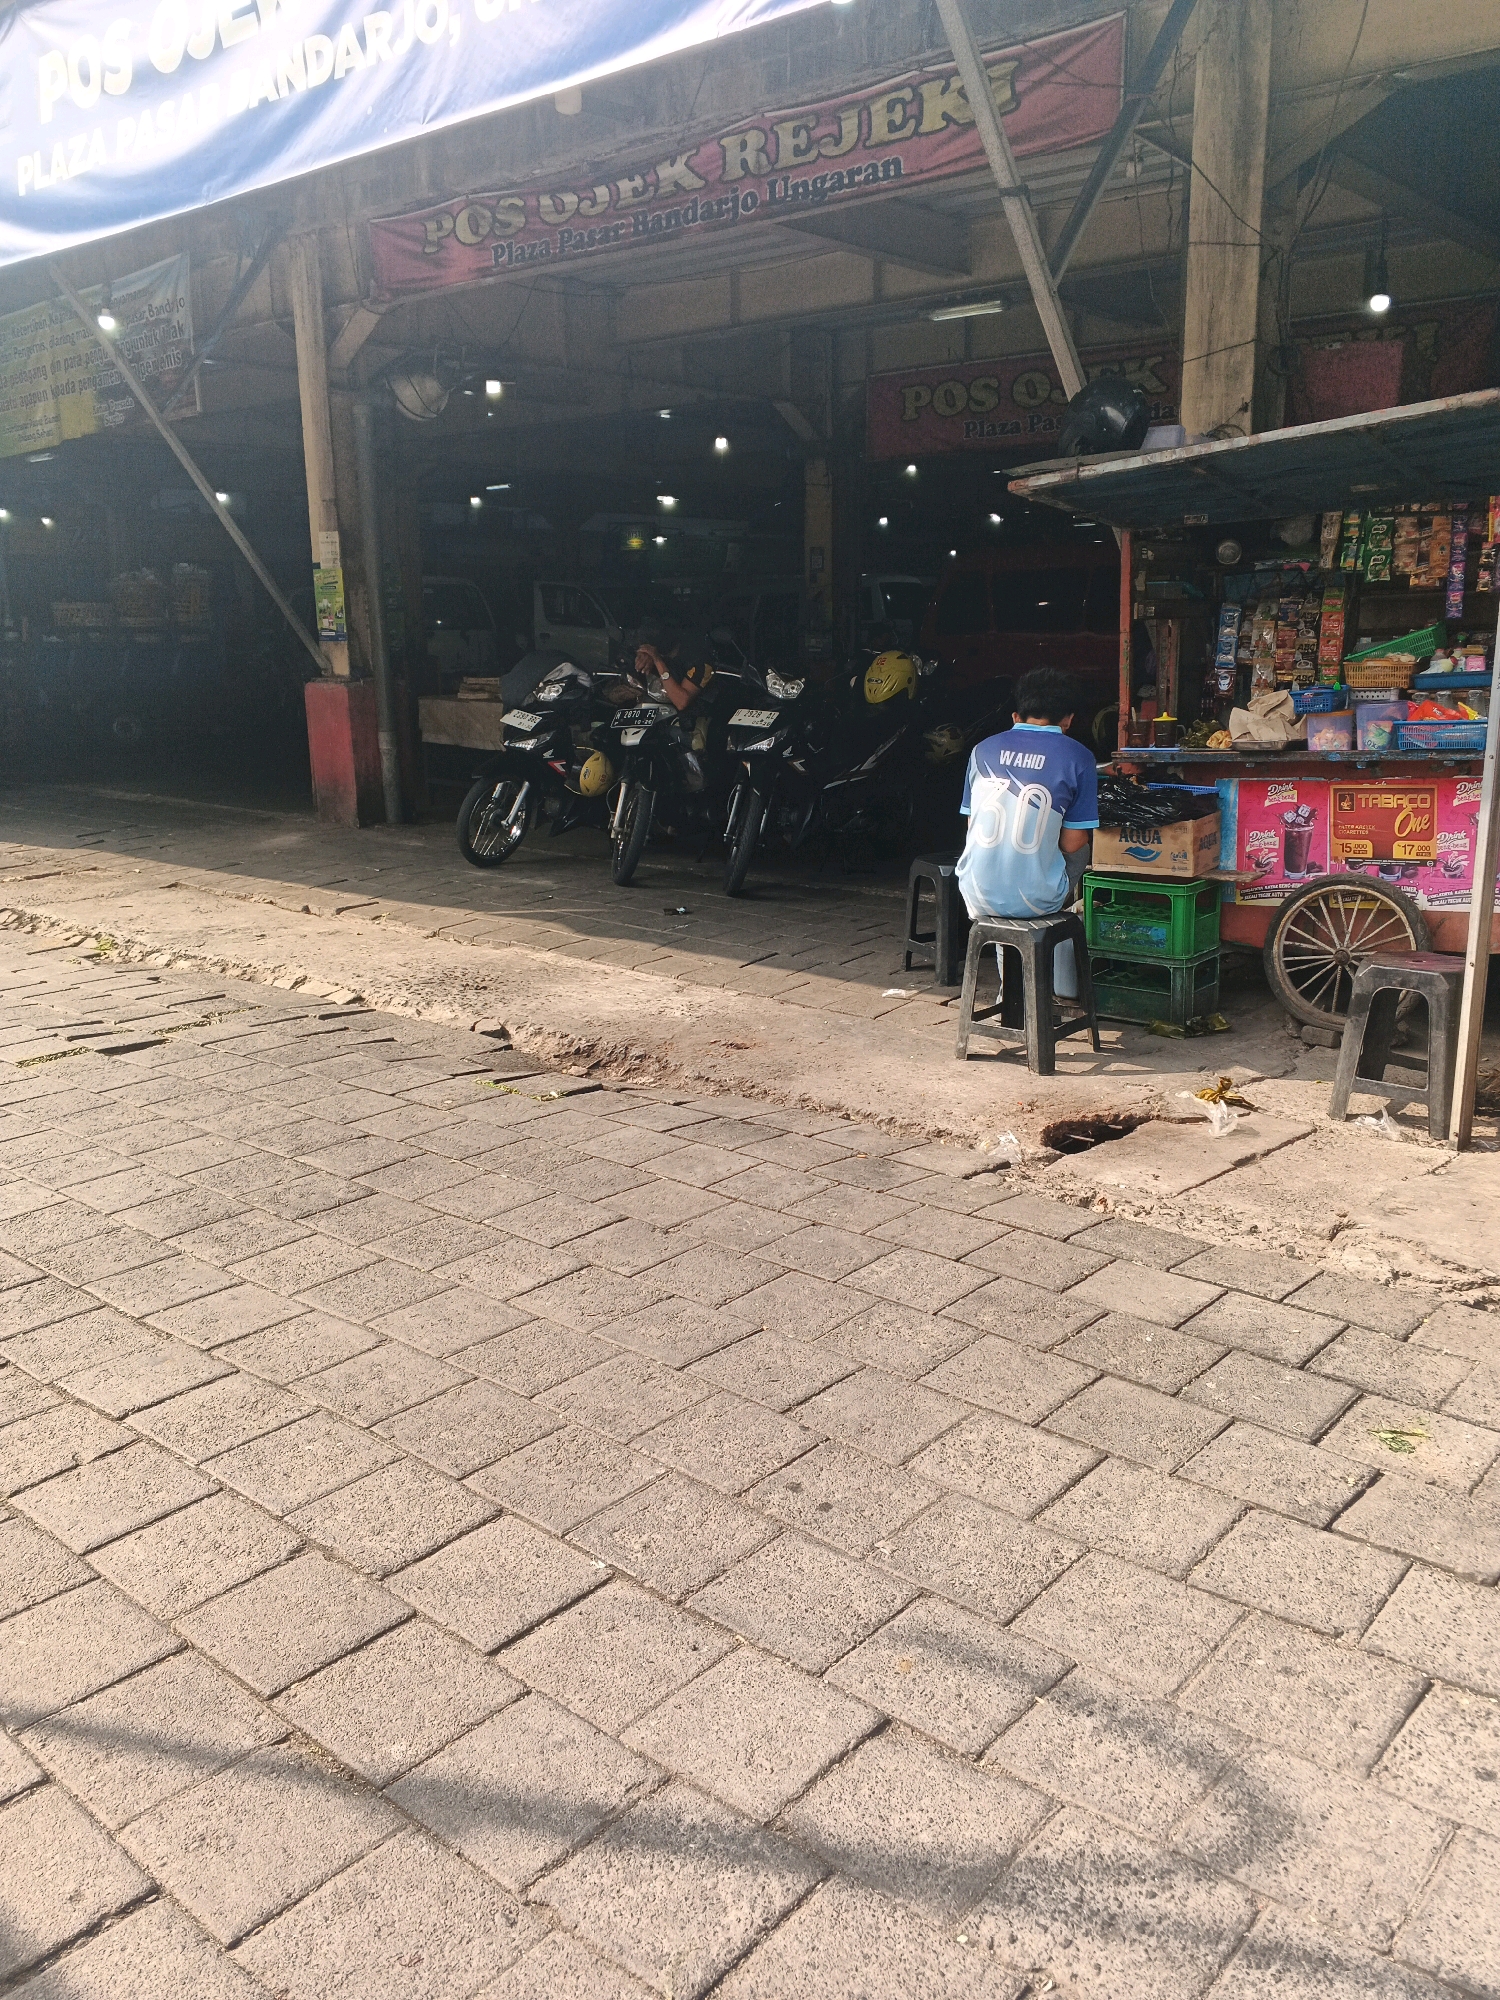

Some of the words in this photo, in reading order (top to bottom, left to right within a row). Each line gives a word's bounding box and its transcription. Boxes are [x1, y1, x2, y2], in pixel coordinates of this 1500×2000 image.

[38, 17, 134, 125] POS
[16, 128, 109, 197] PLAZA
[116, 80, 222, 159] PASAR
[424, 195, 527, 253] POS
[539, 149, 705, 224] OJEK
[491, 236, 551, 270] Plaza
[557, 219, 626, 254] Pasar
[632, 186, 761, 236] Bandarjo
[766, 156, 905, 207] Ungaran
[899, 377, 1000, 422] POS
[962, 417, 1022, 441] Plaza
[623, 710, 641, 719] 2870
[999, 749, 1046, 770] WAHID
[1268, 782, 1294, 797] Drink
[1456, 781, 1482, 795] Drin
[1357, 794, 1432, 808] TABACO
[1394, 807, 1431, 838] One
[1118, 829, 1163, 846] AQUA
[1250, 829, 1276, 844] Drink
[1436, 830, 1467, 845] Drink
